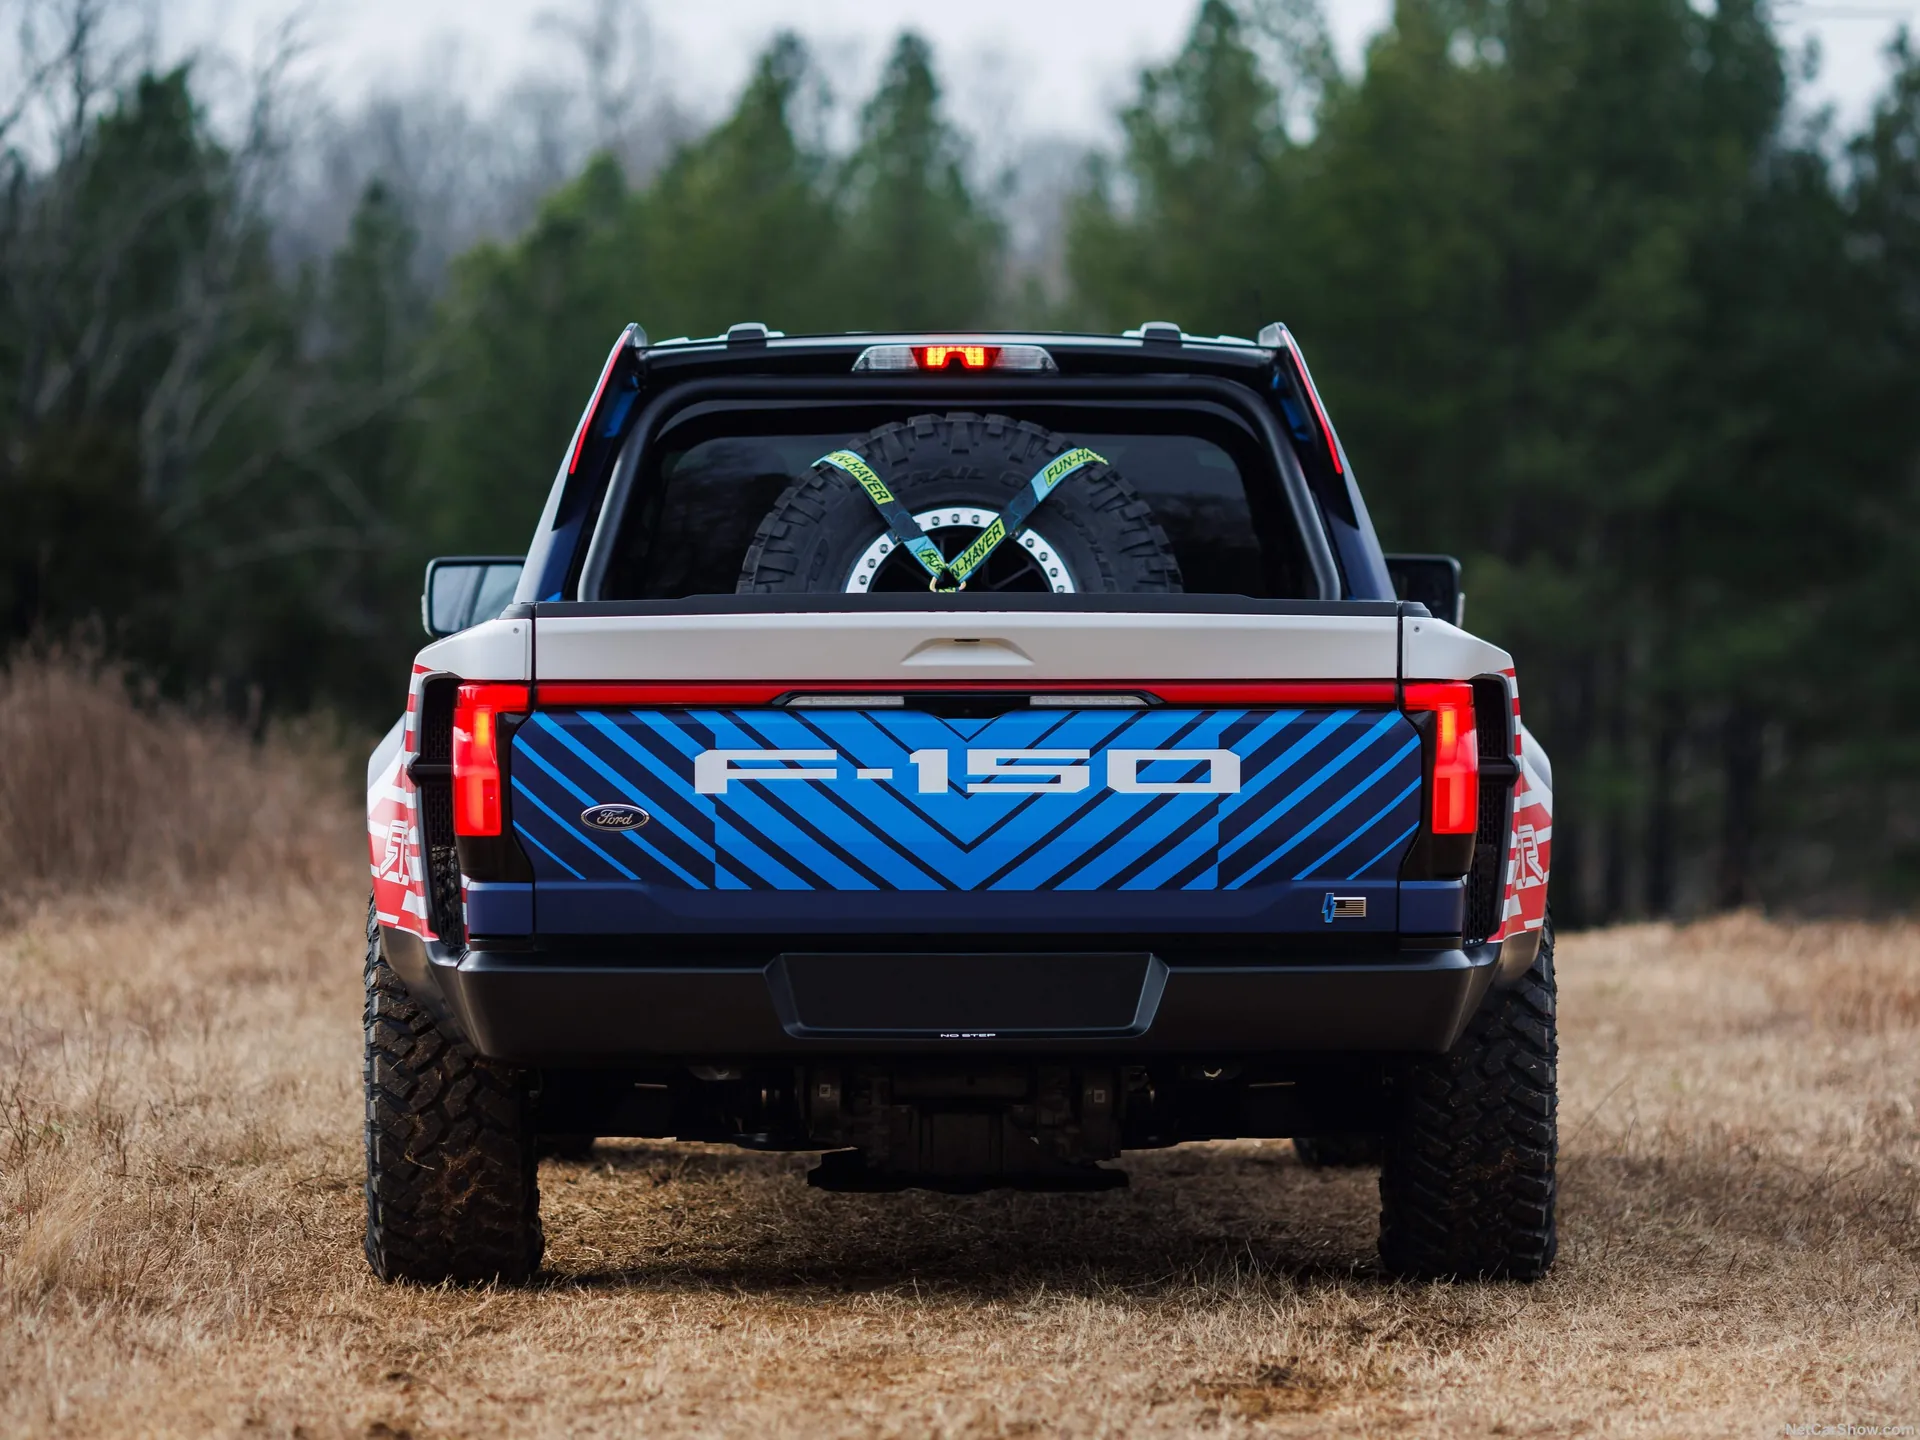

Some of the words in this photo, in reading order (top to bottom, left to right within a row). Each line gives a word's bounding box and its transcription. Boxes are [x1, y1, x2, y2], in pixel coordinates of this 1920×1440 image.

[887, 465, 985, 494] TRAIL
[694, 748, 1241, 794] F-150
[596, 809, 634, 825] Ford
